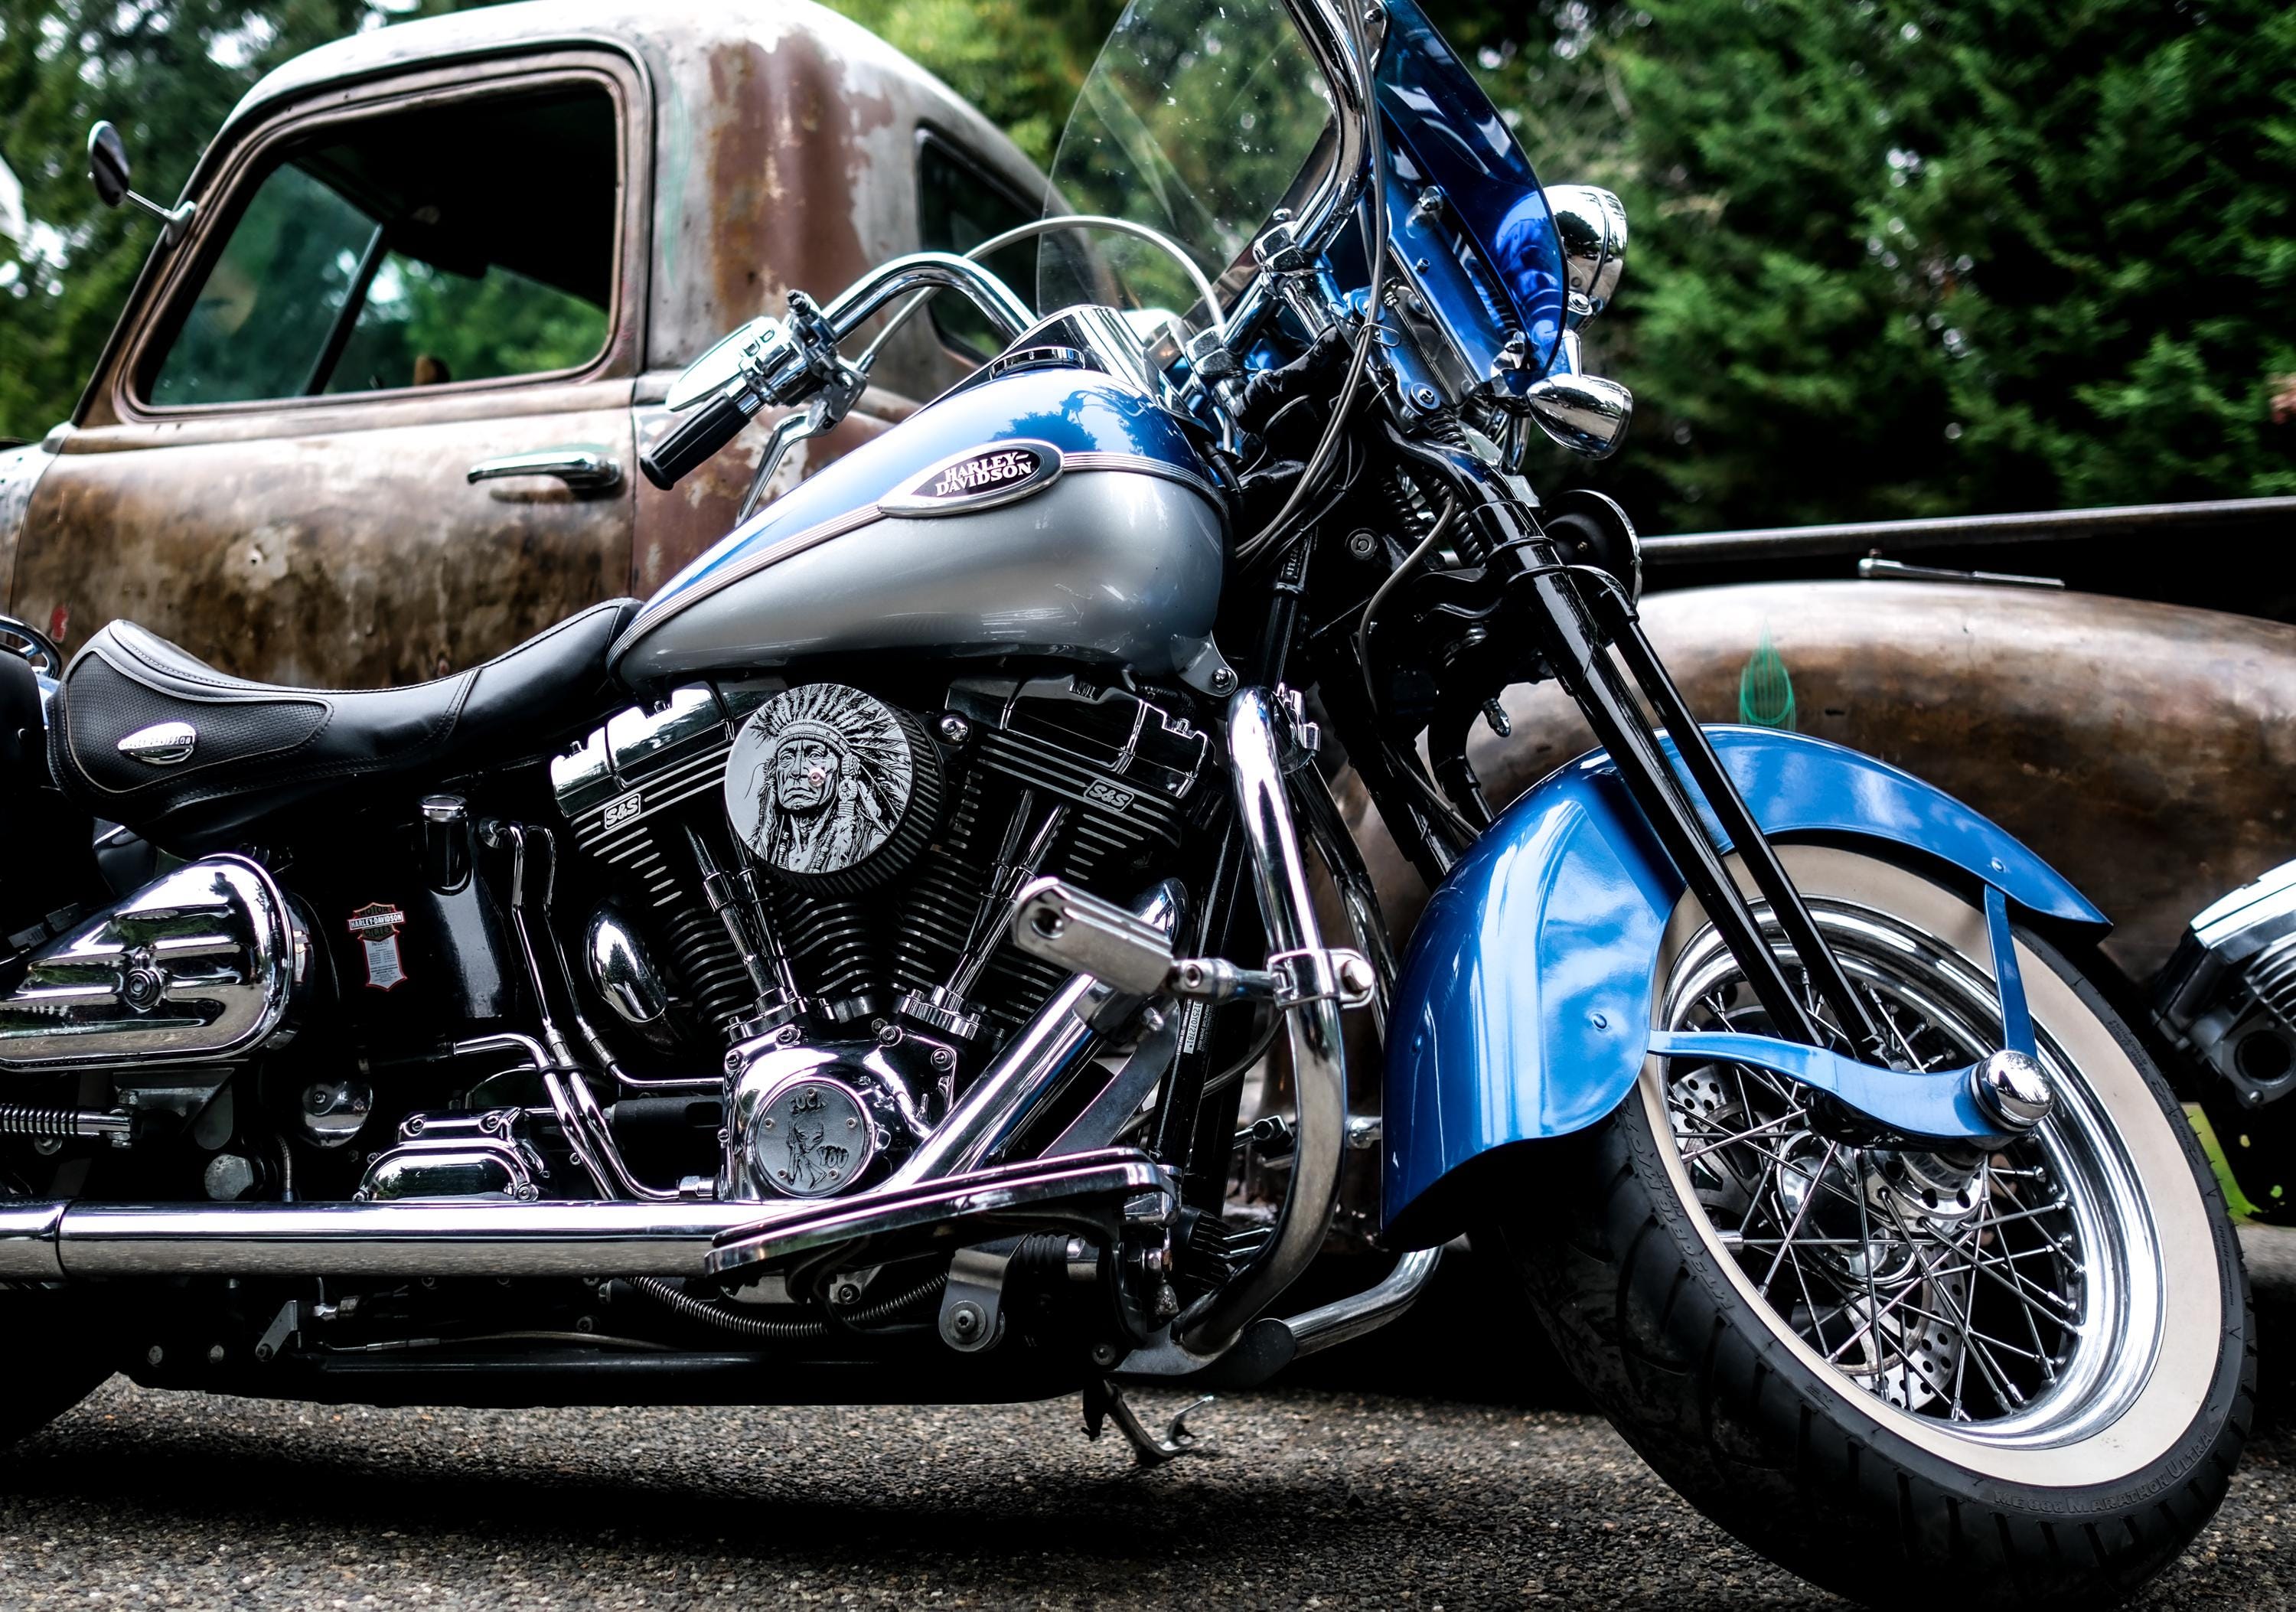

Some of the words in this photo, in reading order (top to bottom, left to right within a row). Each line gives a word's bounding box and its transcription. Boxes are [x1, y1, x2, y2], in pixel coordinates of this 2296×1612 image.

[935, 461, 1032, 498] DAVIDSON
[1088, 785, 1130, 808] S&S
[605, 797, 638, 826] S&S
[350, 913, 403, 929] HARLEY-DAVIDSON
[359, 906, 389, 916] MOTOR
[364, 925, 392, 938] CYCLES
[789, 1092, 828, 1116] FUCK
[817, 1144, 850, 1169] YOU
[2066, 1473, 2170, 1514] MARATHON
[2165, 1432, 2213, 1479] ULTRA
